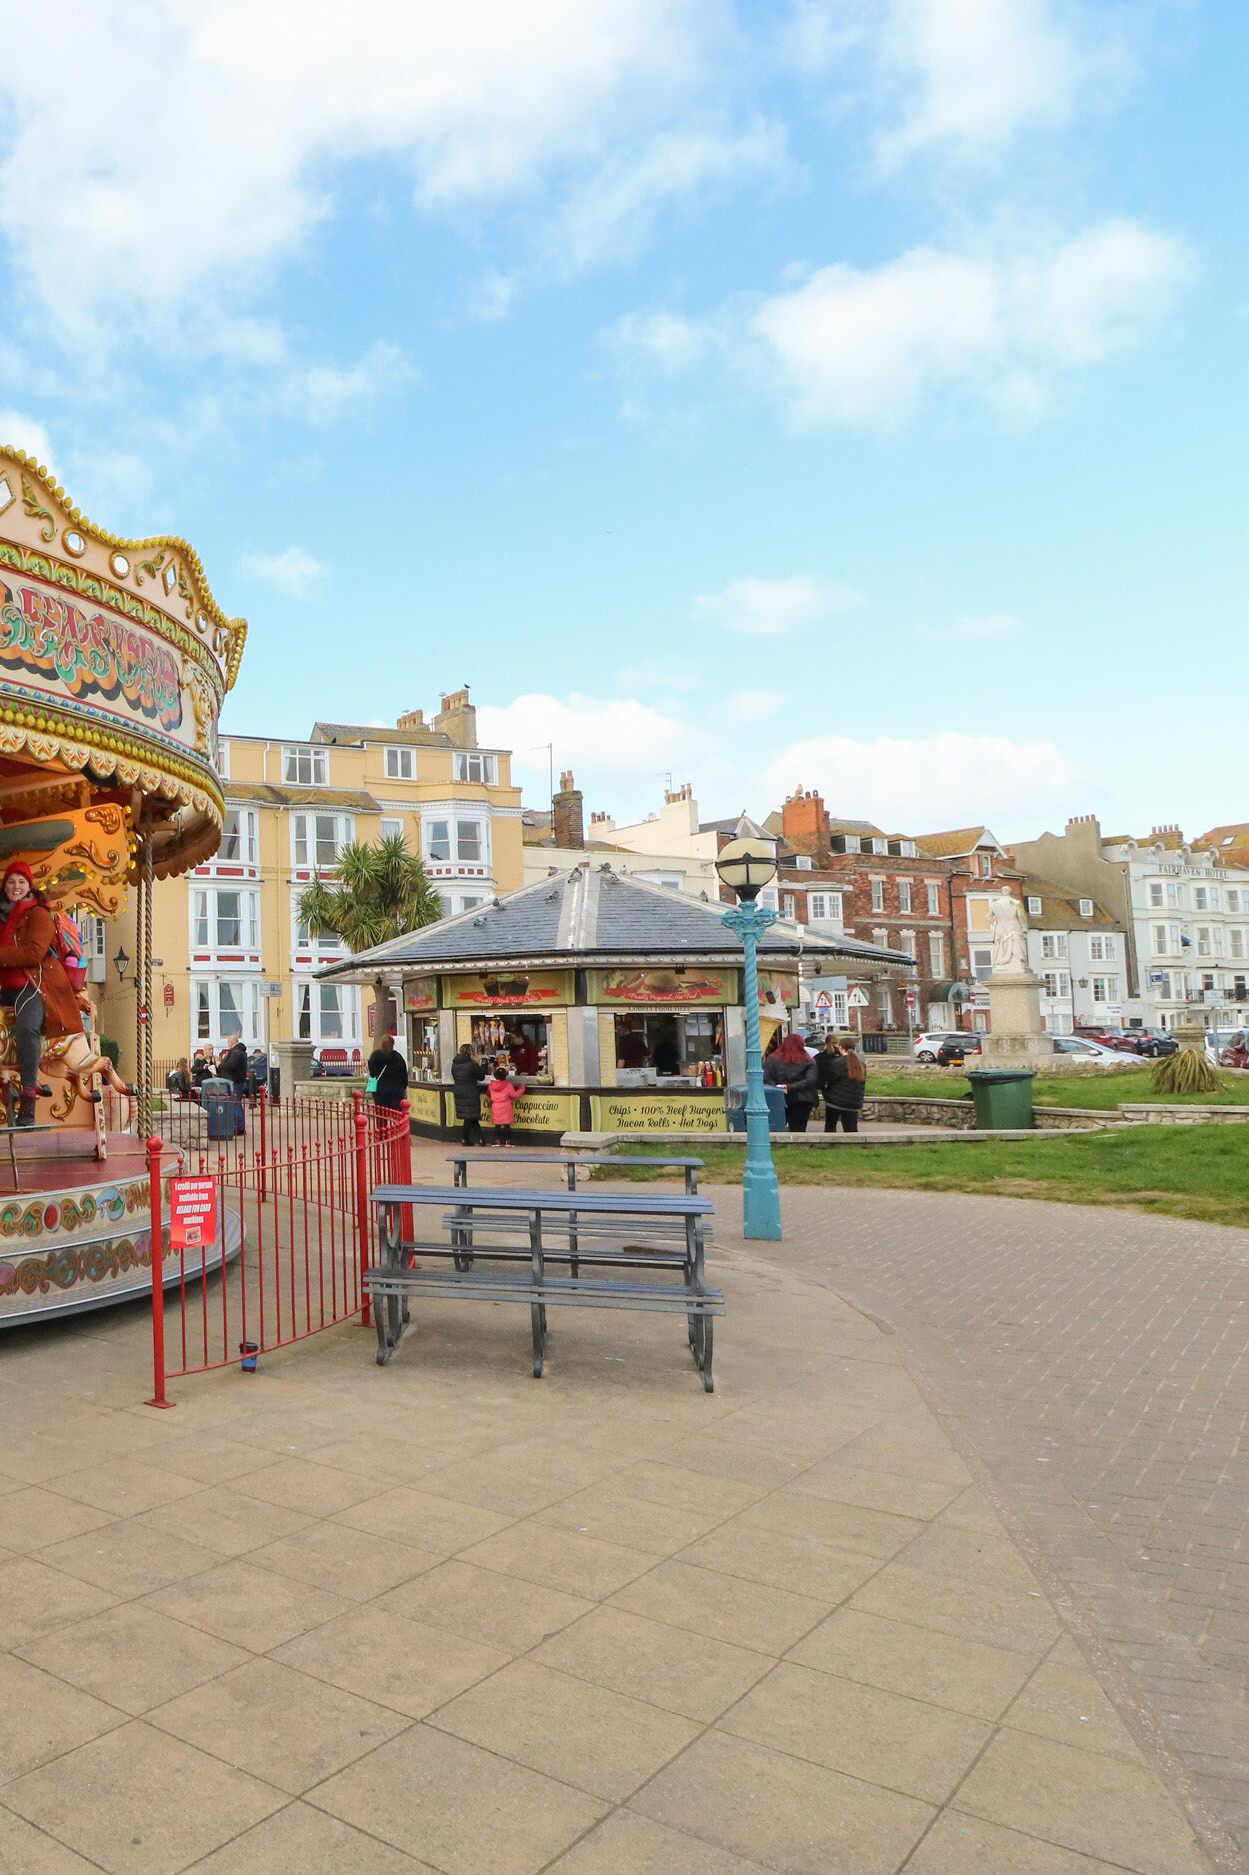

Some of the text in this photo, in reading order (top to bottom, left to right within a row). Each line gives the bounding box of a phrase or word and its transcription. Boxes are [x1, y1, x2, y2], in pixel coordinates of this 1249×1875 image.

[1158, 864, 1229, 879] FAIRHAVEN HOTEL
[514, 1100, 559, 1114] Cappuccino
[609, 1105, 725, 1118] Chips 100% Beef Burgers
[616, 1118, 718, 1131] Bacon Rolls Hot Dogs
[177, 1182, 191, 1190] credit
